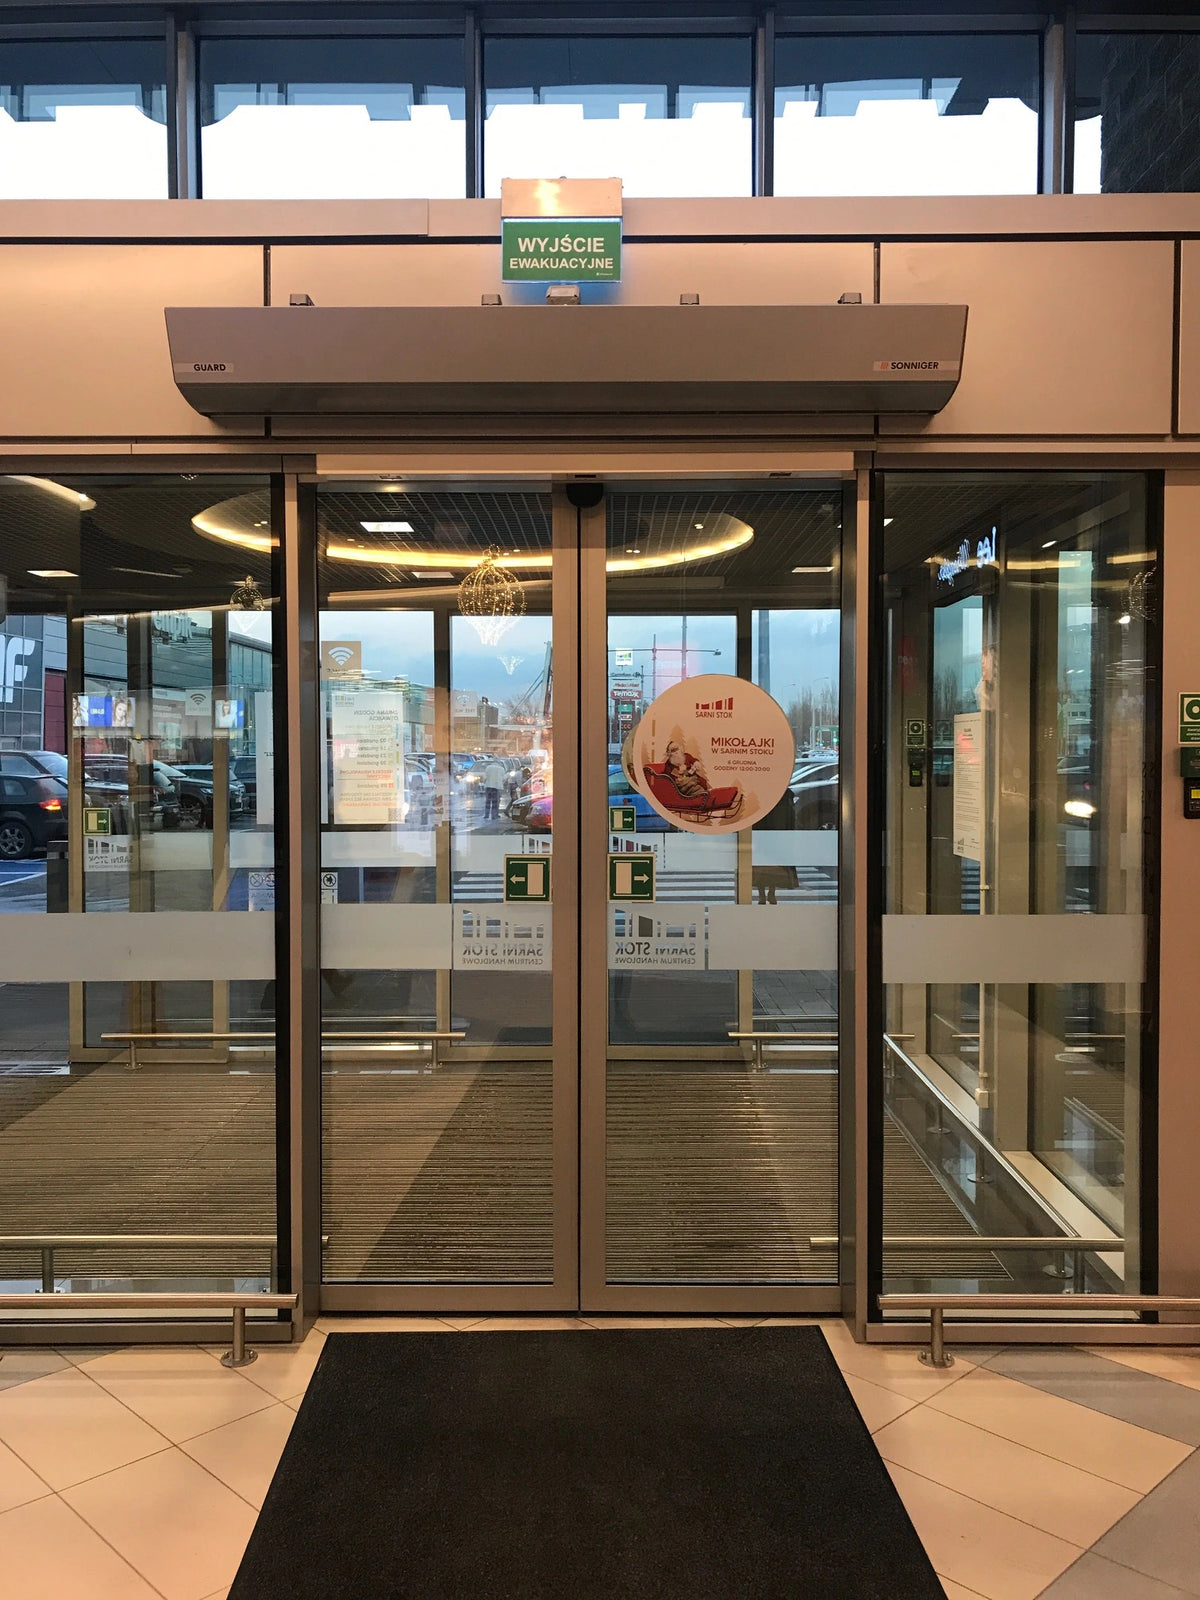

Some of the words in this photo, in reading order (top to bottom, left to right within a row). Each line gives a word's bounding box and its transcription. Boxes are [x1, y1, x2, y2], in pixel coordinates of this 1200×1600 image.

[517, 234, 605, 253] WYJŚCIE
[509, 257, 614, 269] EWAKUACYJNE
[193, 363, 227, 372] GUARD
[890, 361, 939, 370] SONNIGER
[716, 711, 733, 719] STOK
[711, 737, 775, 748] MIKOŁAJKI
[749, 748, 774, 756] STOKU
